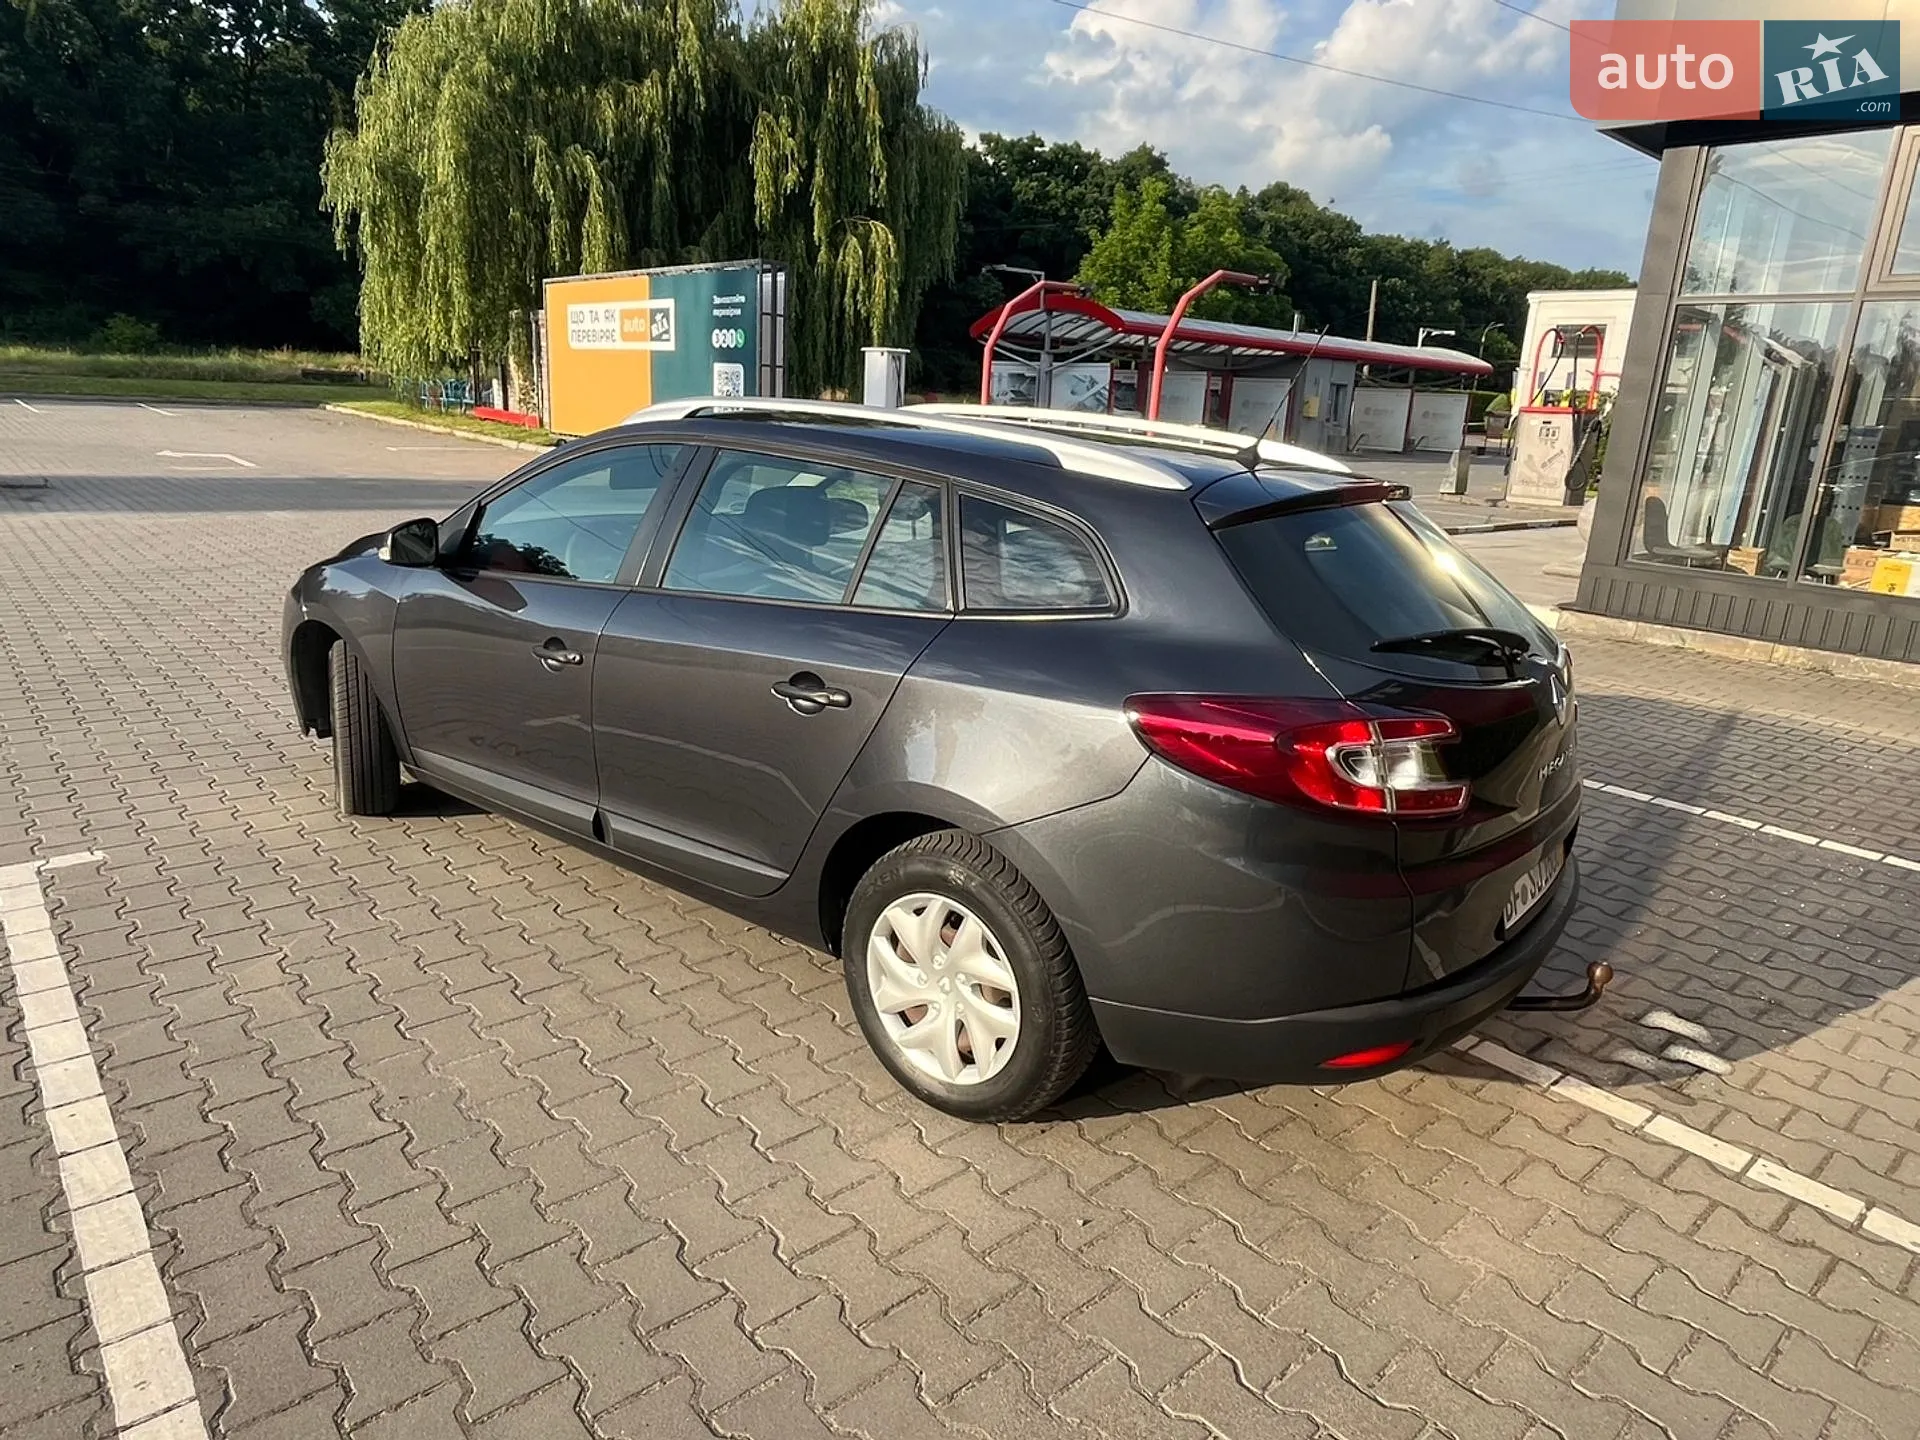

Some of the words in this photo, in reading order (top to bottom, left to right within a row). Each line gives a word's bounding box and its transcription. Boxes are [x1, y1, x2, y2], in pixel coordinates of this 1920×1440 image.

[570, 310, 586, 326] ЩО
[588, 310, 600, 325] ТА
[603, 308, 617, 324] ЯК
[623, 316, 646, 333] auto
[570, 328, 617, 343] ПЕРЕВІРЯЄ
